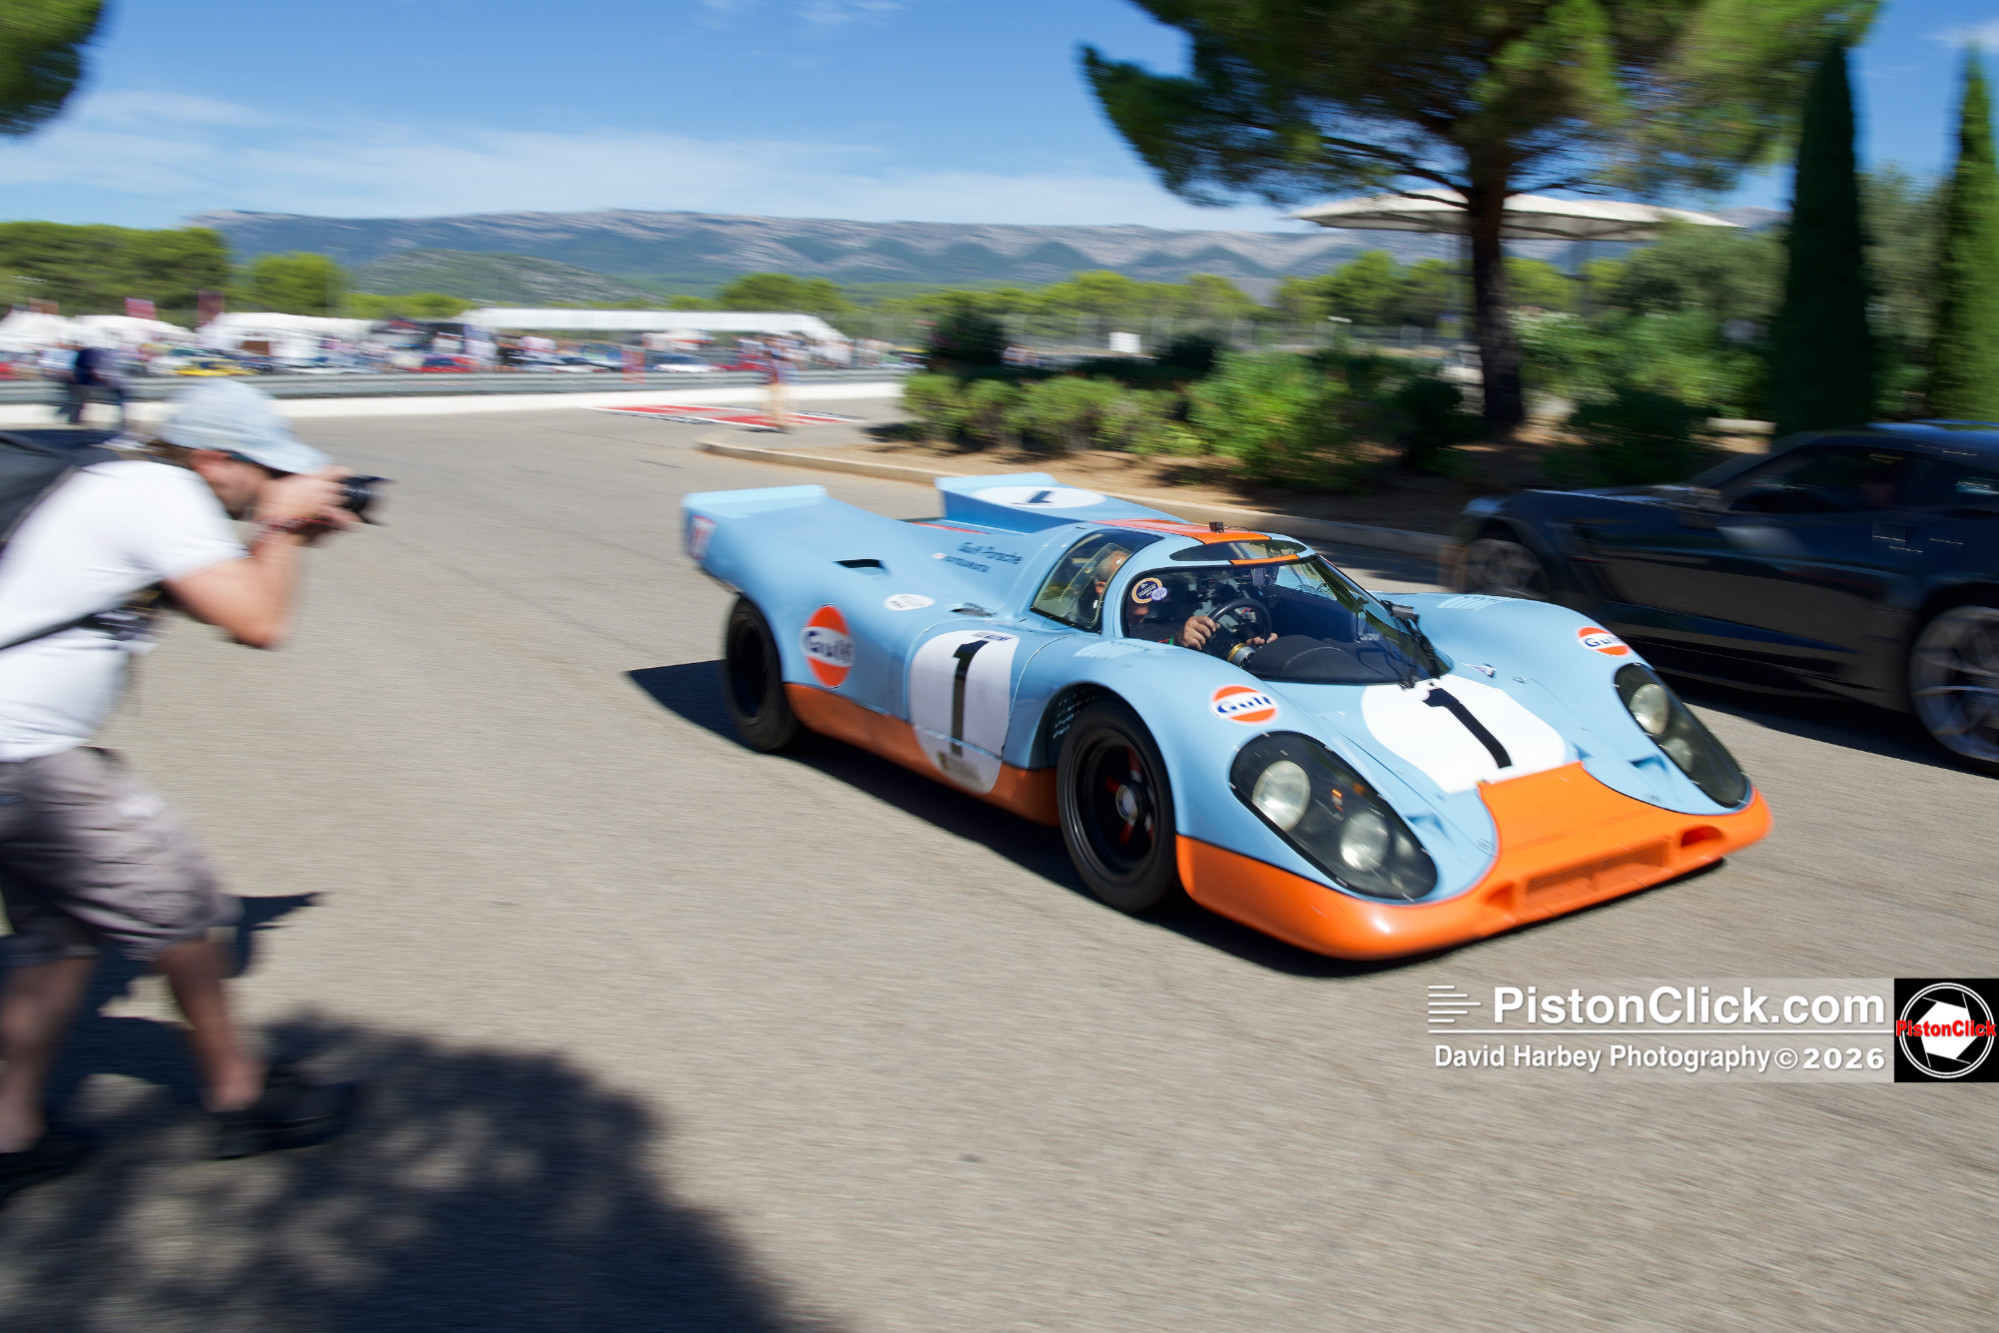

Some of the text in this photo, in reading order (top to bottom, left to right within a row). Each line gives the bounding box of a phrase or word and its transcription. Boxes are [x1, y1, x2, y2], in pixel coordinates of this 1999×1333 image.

[804, 630, 854, 664] Gulf
[952, 639, 991, 758] 1
[1216, 696, 1273, 714] Gulf
[1422, 687, 1513, 769] 1
